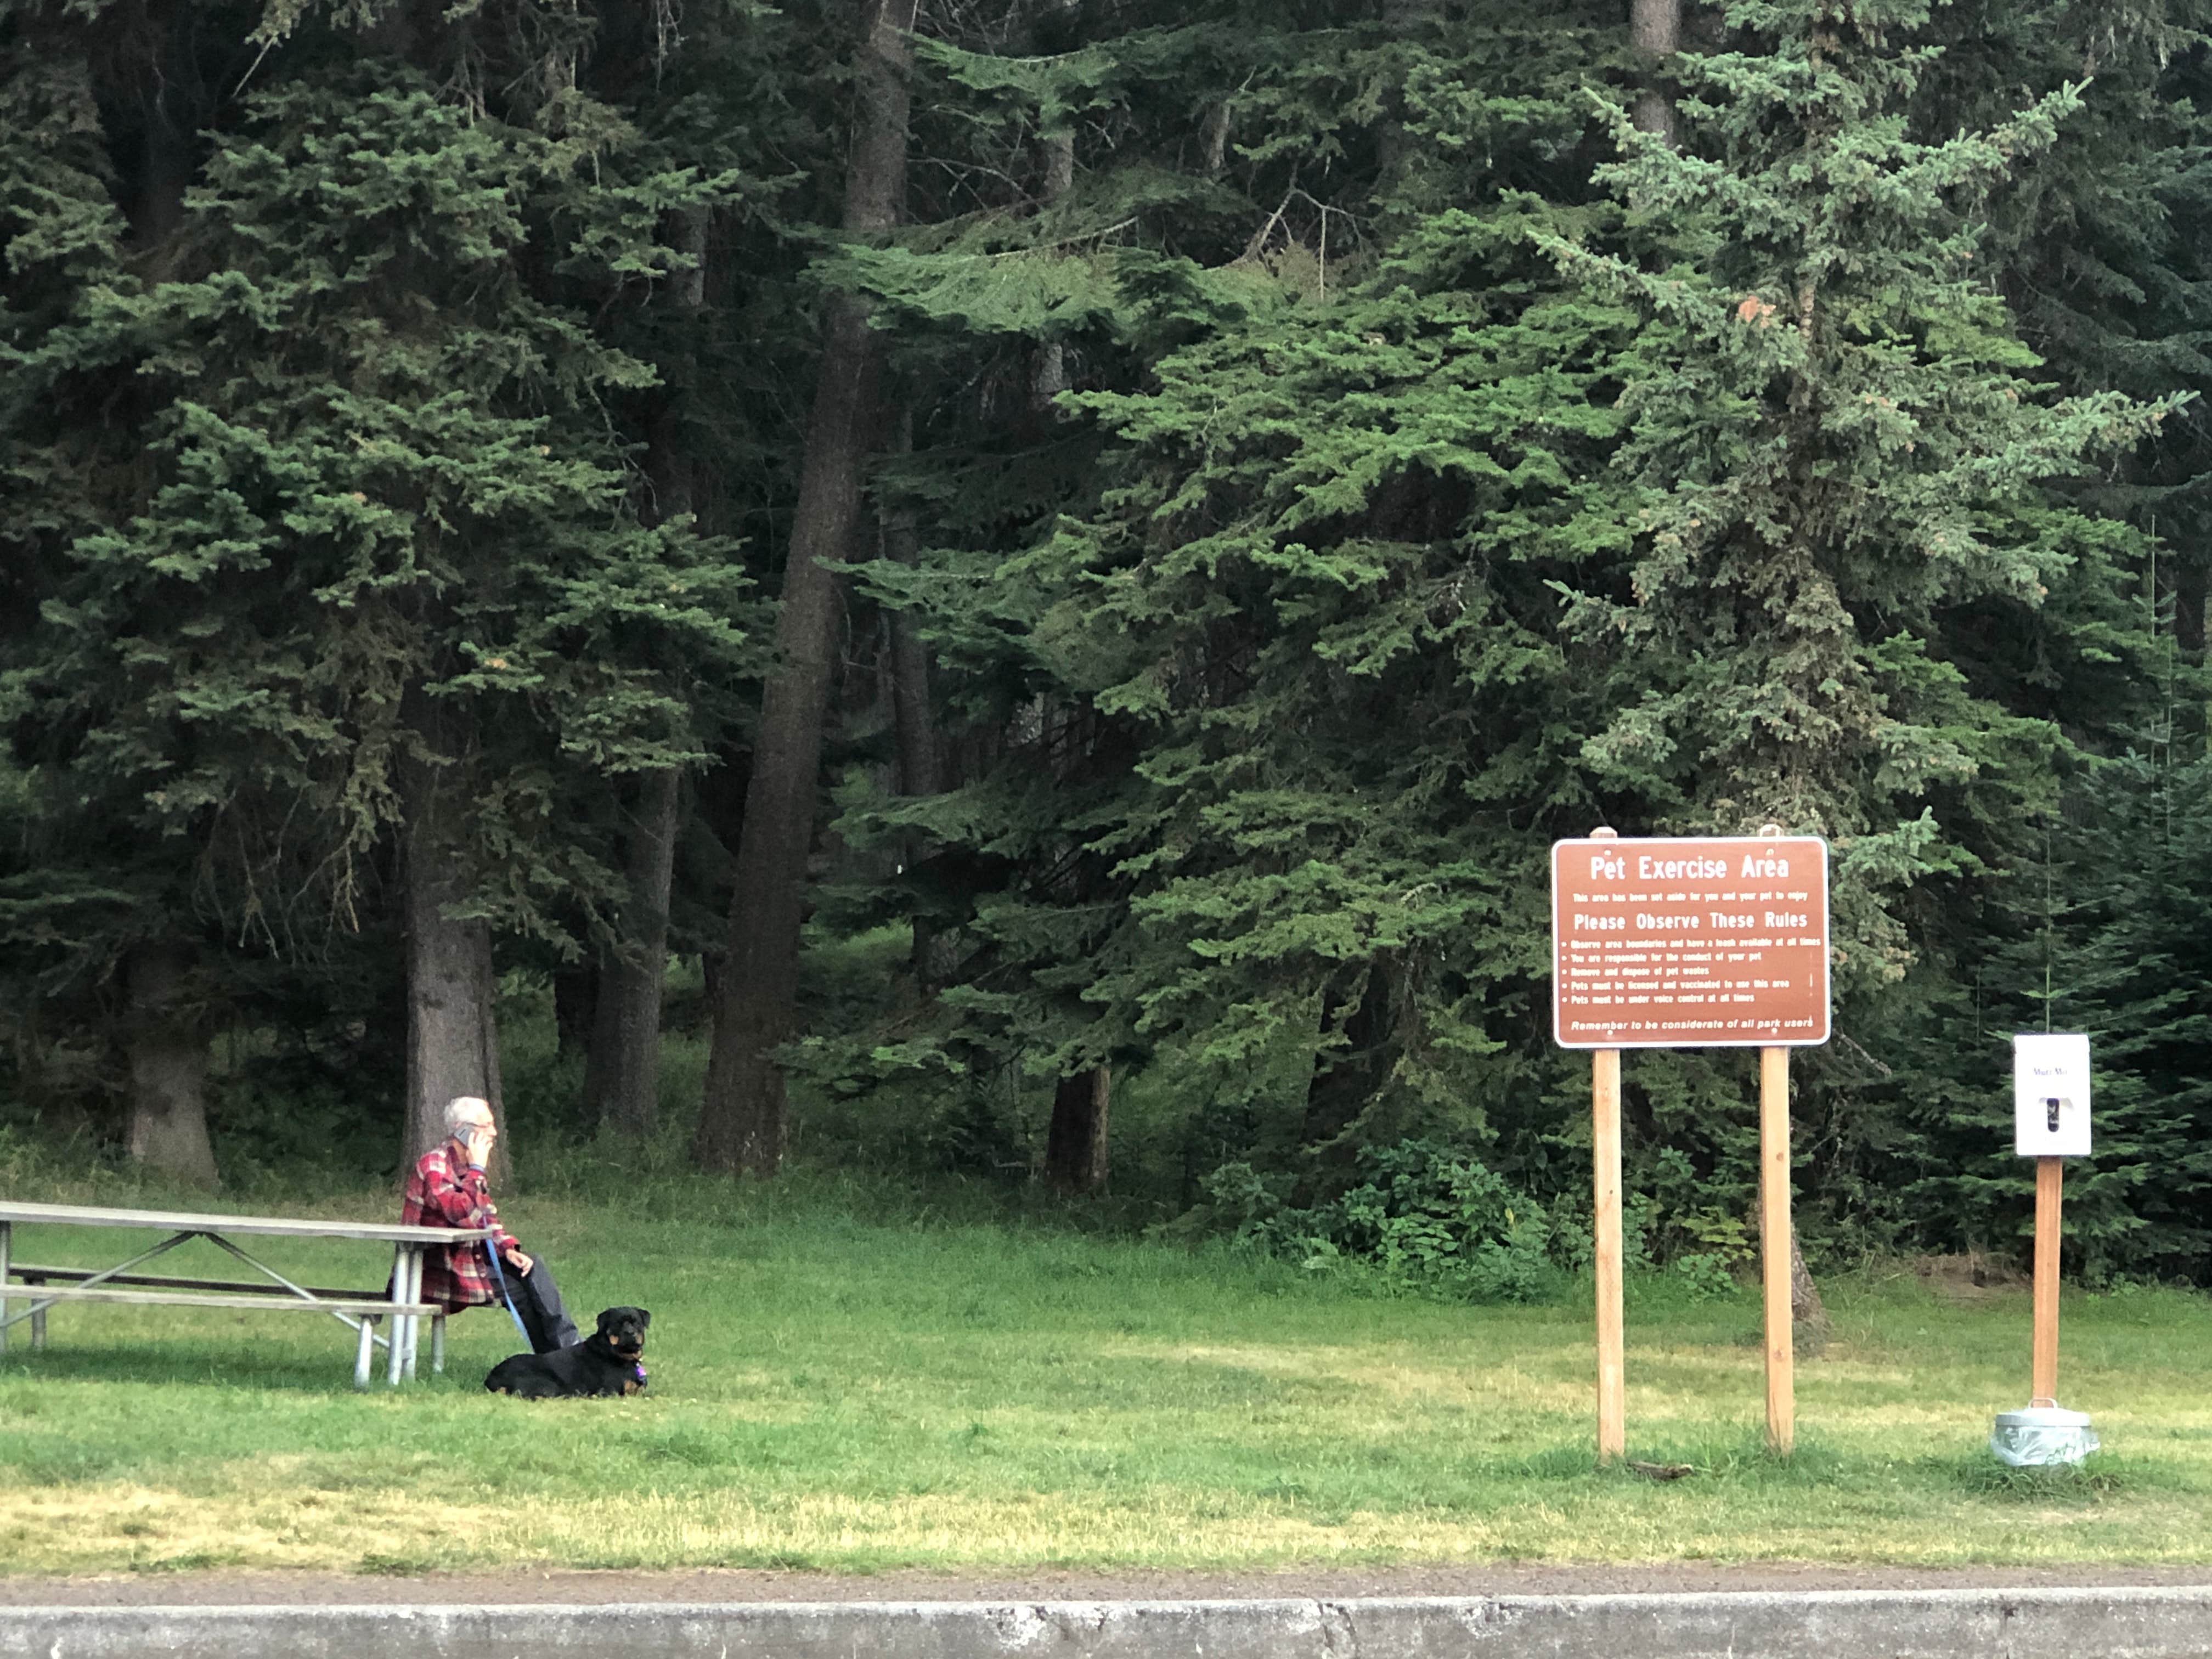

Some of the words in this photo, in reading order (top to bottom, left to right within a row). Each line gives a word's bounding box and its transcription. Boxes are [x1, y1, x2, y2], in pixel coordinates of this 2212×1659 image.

[1590, 856, 1626, 880] Pet
[1639, 856, 1728, 879] Exercise
[1741, 854, 1789, 878] Area
[1573, 893, 1589, 902] This
[1592, 894, 1609, 902] area
[1612, 893, 1627, 902] has
[1629, 893, 1647, 902] been
[1650, 893, 1663, 901] set
[1689, 892, 1701, 901] for
[1704, 893, 1719, 902] you
[1722, 891, 1736, 900] and
[1739, 893, 1757, 902] your
[1759, 891, 1772, 901] pet
[1775, 891, 1785, 900] to
[1787, 891, 1808, 902] enjoy
[1574, 913, 1626, 930] Please
[1636, 912, 1700, 930] Observe
[1709, 912, 1755, 928] These
[1764, 911, 1808, 928] Rules
[1570, 940, 1601, 949] Observe
[1669, 939, 1684, 948] and
[1686, 939, 1705, 948] have
[1739, 938, 1773, 947] available
[1775, 938, 1784, 946] at
[1786, 938, 1797, 946] all
[1799, 937, 1821, 946] times
[1571, 953, 1584, 963] You
[1588, 955, 1601, 963] are
[1605, 953, 1647, 963] responsible
[1651, 953, 1662, 962] for
[1666, 953, 1679, 962] the
[1683, 952, 1712, 962] conduct
[1715, 952, 1724, 961] of
[1728, 953, 1746, 963] your
[1748, 952, 1762, 962] pet
[1571, 967, 1600, 977] Remove
[1604, 967, 1618, 977] and
[1622, 967, 1650, 977] dispose
[1654, 967, 1662, 976] of
[1666, 967, 1679, 977] pet
[1683, 966, 1709, 975] wastes
[1571, 981, 1588, 991] Pets
[1592, 981, 1611, 990] must
[1615, 981, 1624, 990] be
[1628, 981, 1659, 990] licensed
[1662, 980, 1677, 990] and
[1680, 980, 1721, 989] vaccinated
[1724, 980, 1733, 989] to
[1736, 980, 1750, 989] use
[1753, 979, 1769, 988] this
[1771, 980, 1790, 988] area
[1571, 995, 1589, 1005] Pets
[1592, 995, 1611, 1005] must
[1615, 995, 1625, 1004] be
[1628, 995, 1650, 1004] under
[1654, 995, 1674, 1003] voice
[1677, 994, 1704, 1003] control
[1707, 994, 1716, 1003] at
[1720, 994, 1730, 1003] all
[1733, 994, 1755, 1002] times
[1571, 1020, 1629, 1030] Remember
[1630, 1021, 1642, 1030] to
[1645, 1020, 1658, 1030] be
[1661, 1020, 1724, 1029] considerate
[1726, 1019, 1739, 1028] of
[1740, 1019, 1754, 1028] all
[1757, 1018, 1781, 1030] park
[1784, 1018, 1813, 1028] users
